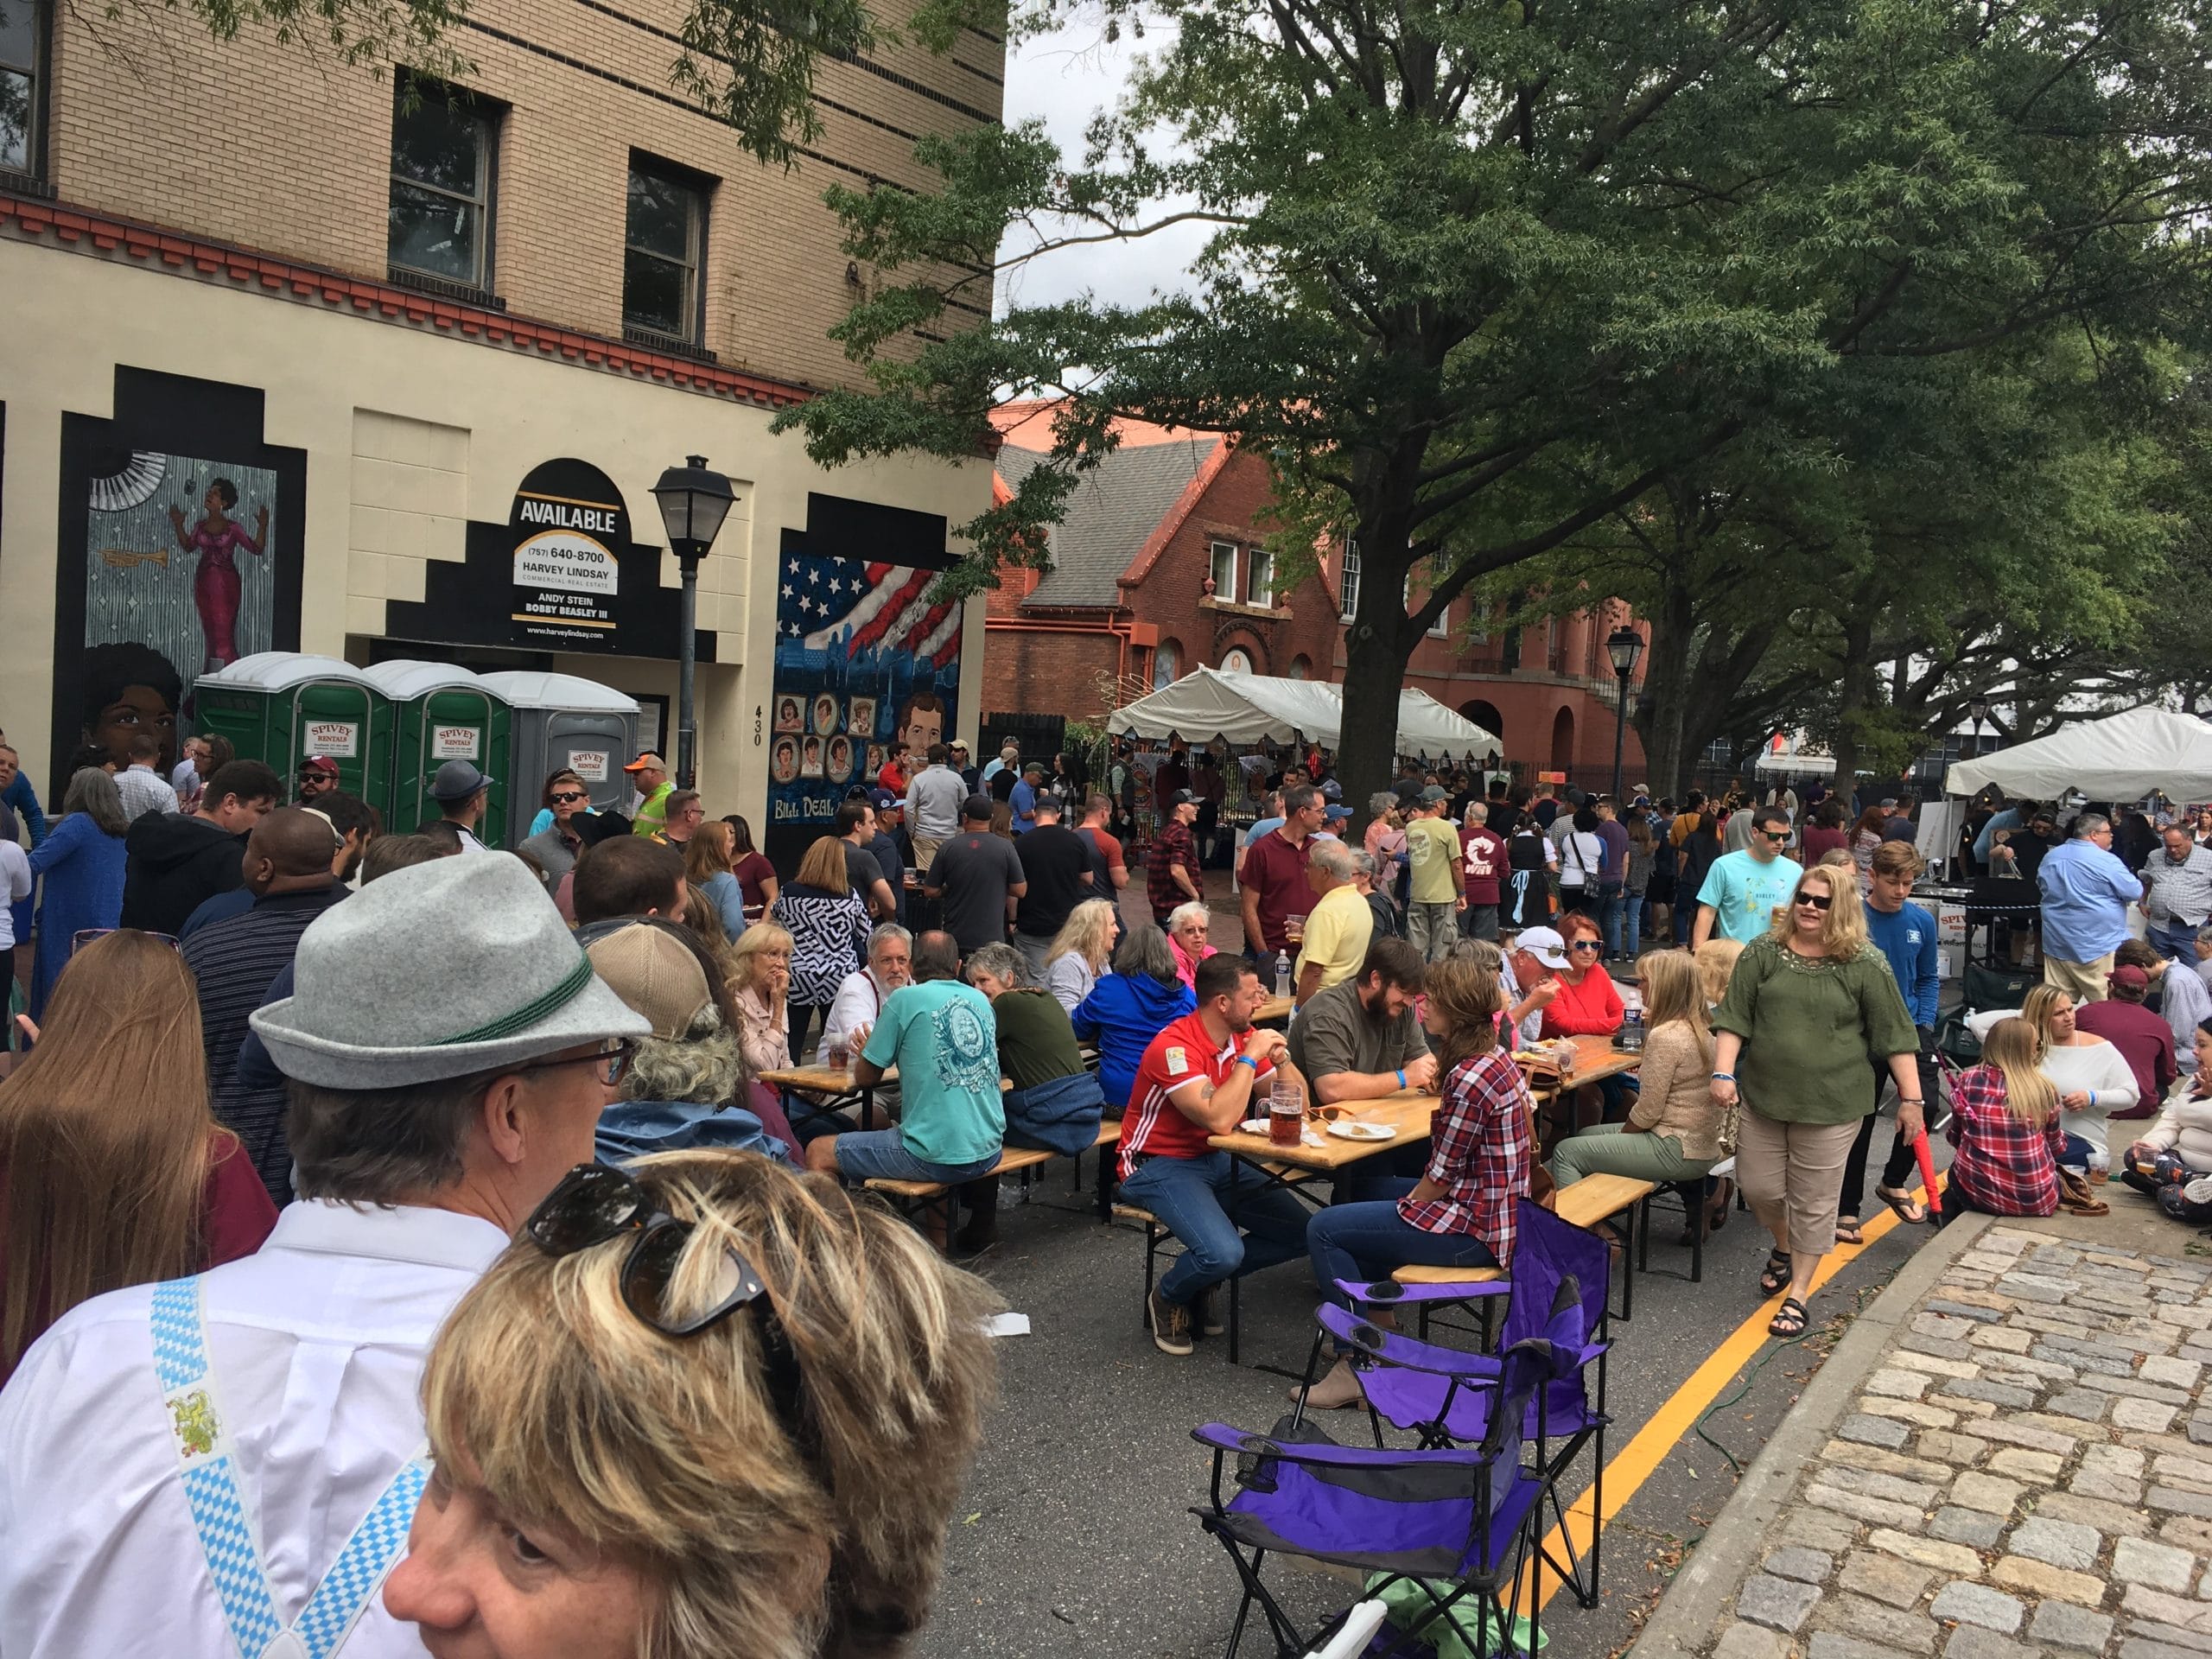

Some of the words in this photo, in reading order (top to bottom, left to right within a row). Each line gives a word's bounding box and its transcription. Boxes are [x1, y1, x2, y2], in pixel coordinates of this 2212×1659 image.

[520, 500, 616, 533] AVAILABLE
[528, 548, 549, 558] (757)
[550, 548, 605, 563] 640-8700
[523, 562, 564, 575] HARVEY
[567, 567, 609, 580] LINDSAY
[522, 575, 565, 584] COMMERCIAL
[538, 593, 565, 603] ANDY
[567, 595, 594, 607] STEIN
[525, 602, 557, 614] BOBBY
[559, 606, 597, 618] BEASLEY
[599, 610, 607, 619] III
[527, 626, 604, 639] www.harveylindsay.com
[311, 724, 353, 735] SPIVEY
[439, 728, 476, 740] SPIVEY
[573, 753, 605, 763] SPIVEY
[1465, 864, 1493, 875] WRV
